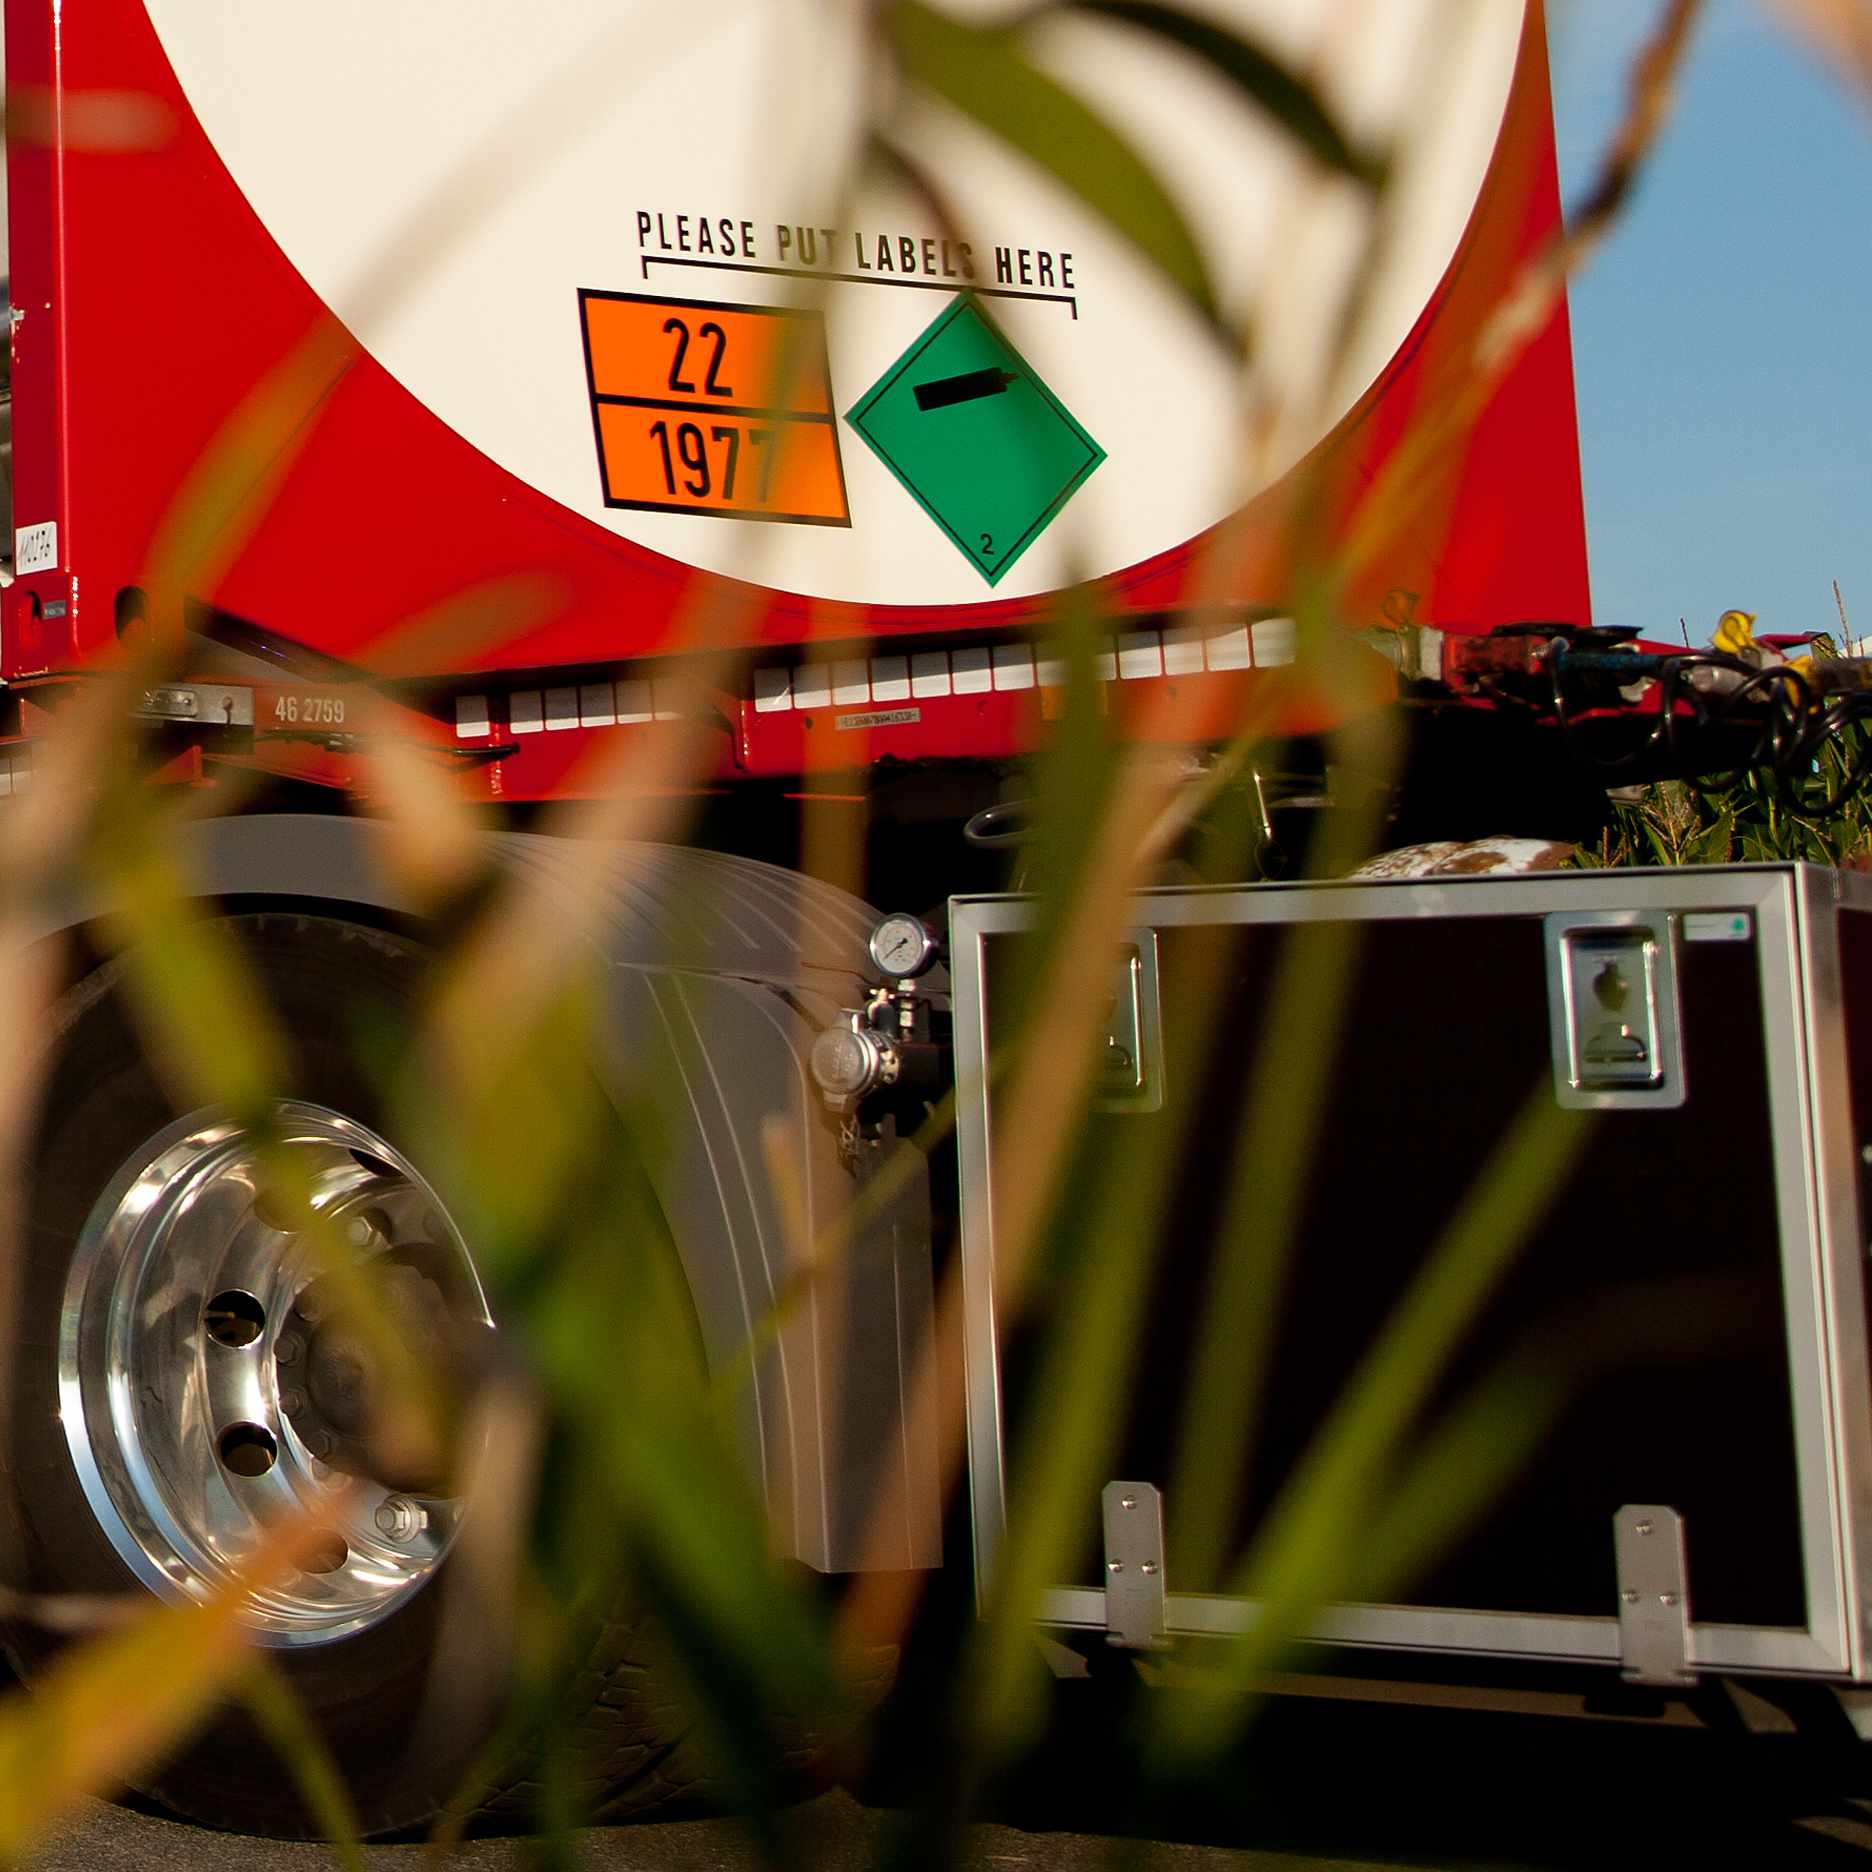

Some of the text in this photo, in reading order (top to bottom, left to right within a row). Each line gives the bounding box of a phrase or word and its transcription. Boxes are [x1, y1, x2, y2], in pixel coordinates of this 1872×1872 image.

[637, 211, 1076, 289] PLEASE PUT LABELS HERE
[663, 318, 733, 398] 22
[649, 420, 778, 504] 1977
[980, 532, 995, 555] 2
[275, 697, 344, 723] 46 2759
